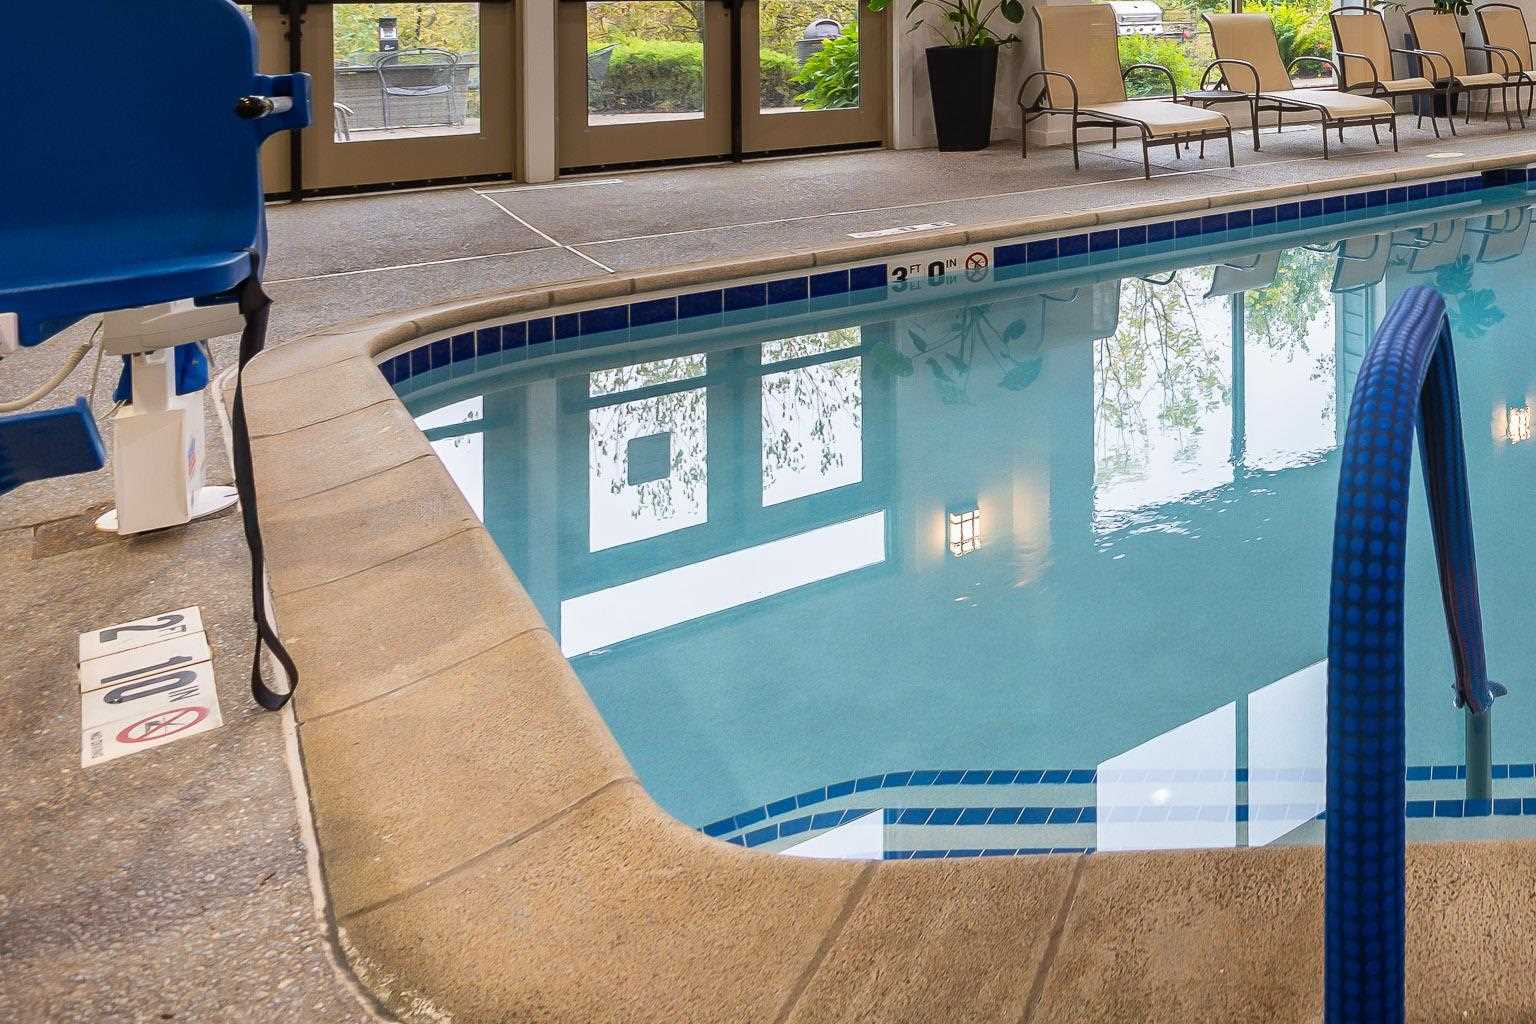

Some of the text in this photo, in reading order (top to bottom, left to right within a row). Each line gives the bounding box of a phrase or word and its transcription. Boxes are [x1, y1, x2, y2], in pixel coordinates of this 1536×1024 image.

[910, 264, 921, 273] FT
[947, 258, 957, 268] IN
[168, 685, 200, 703] IN
